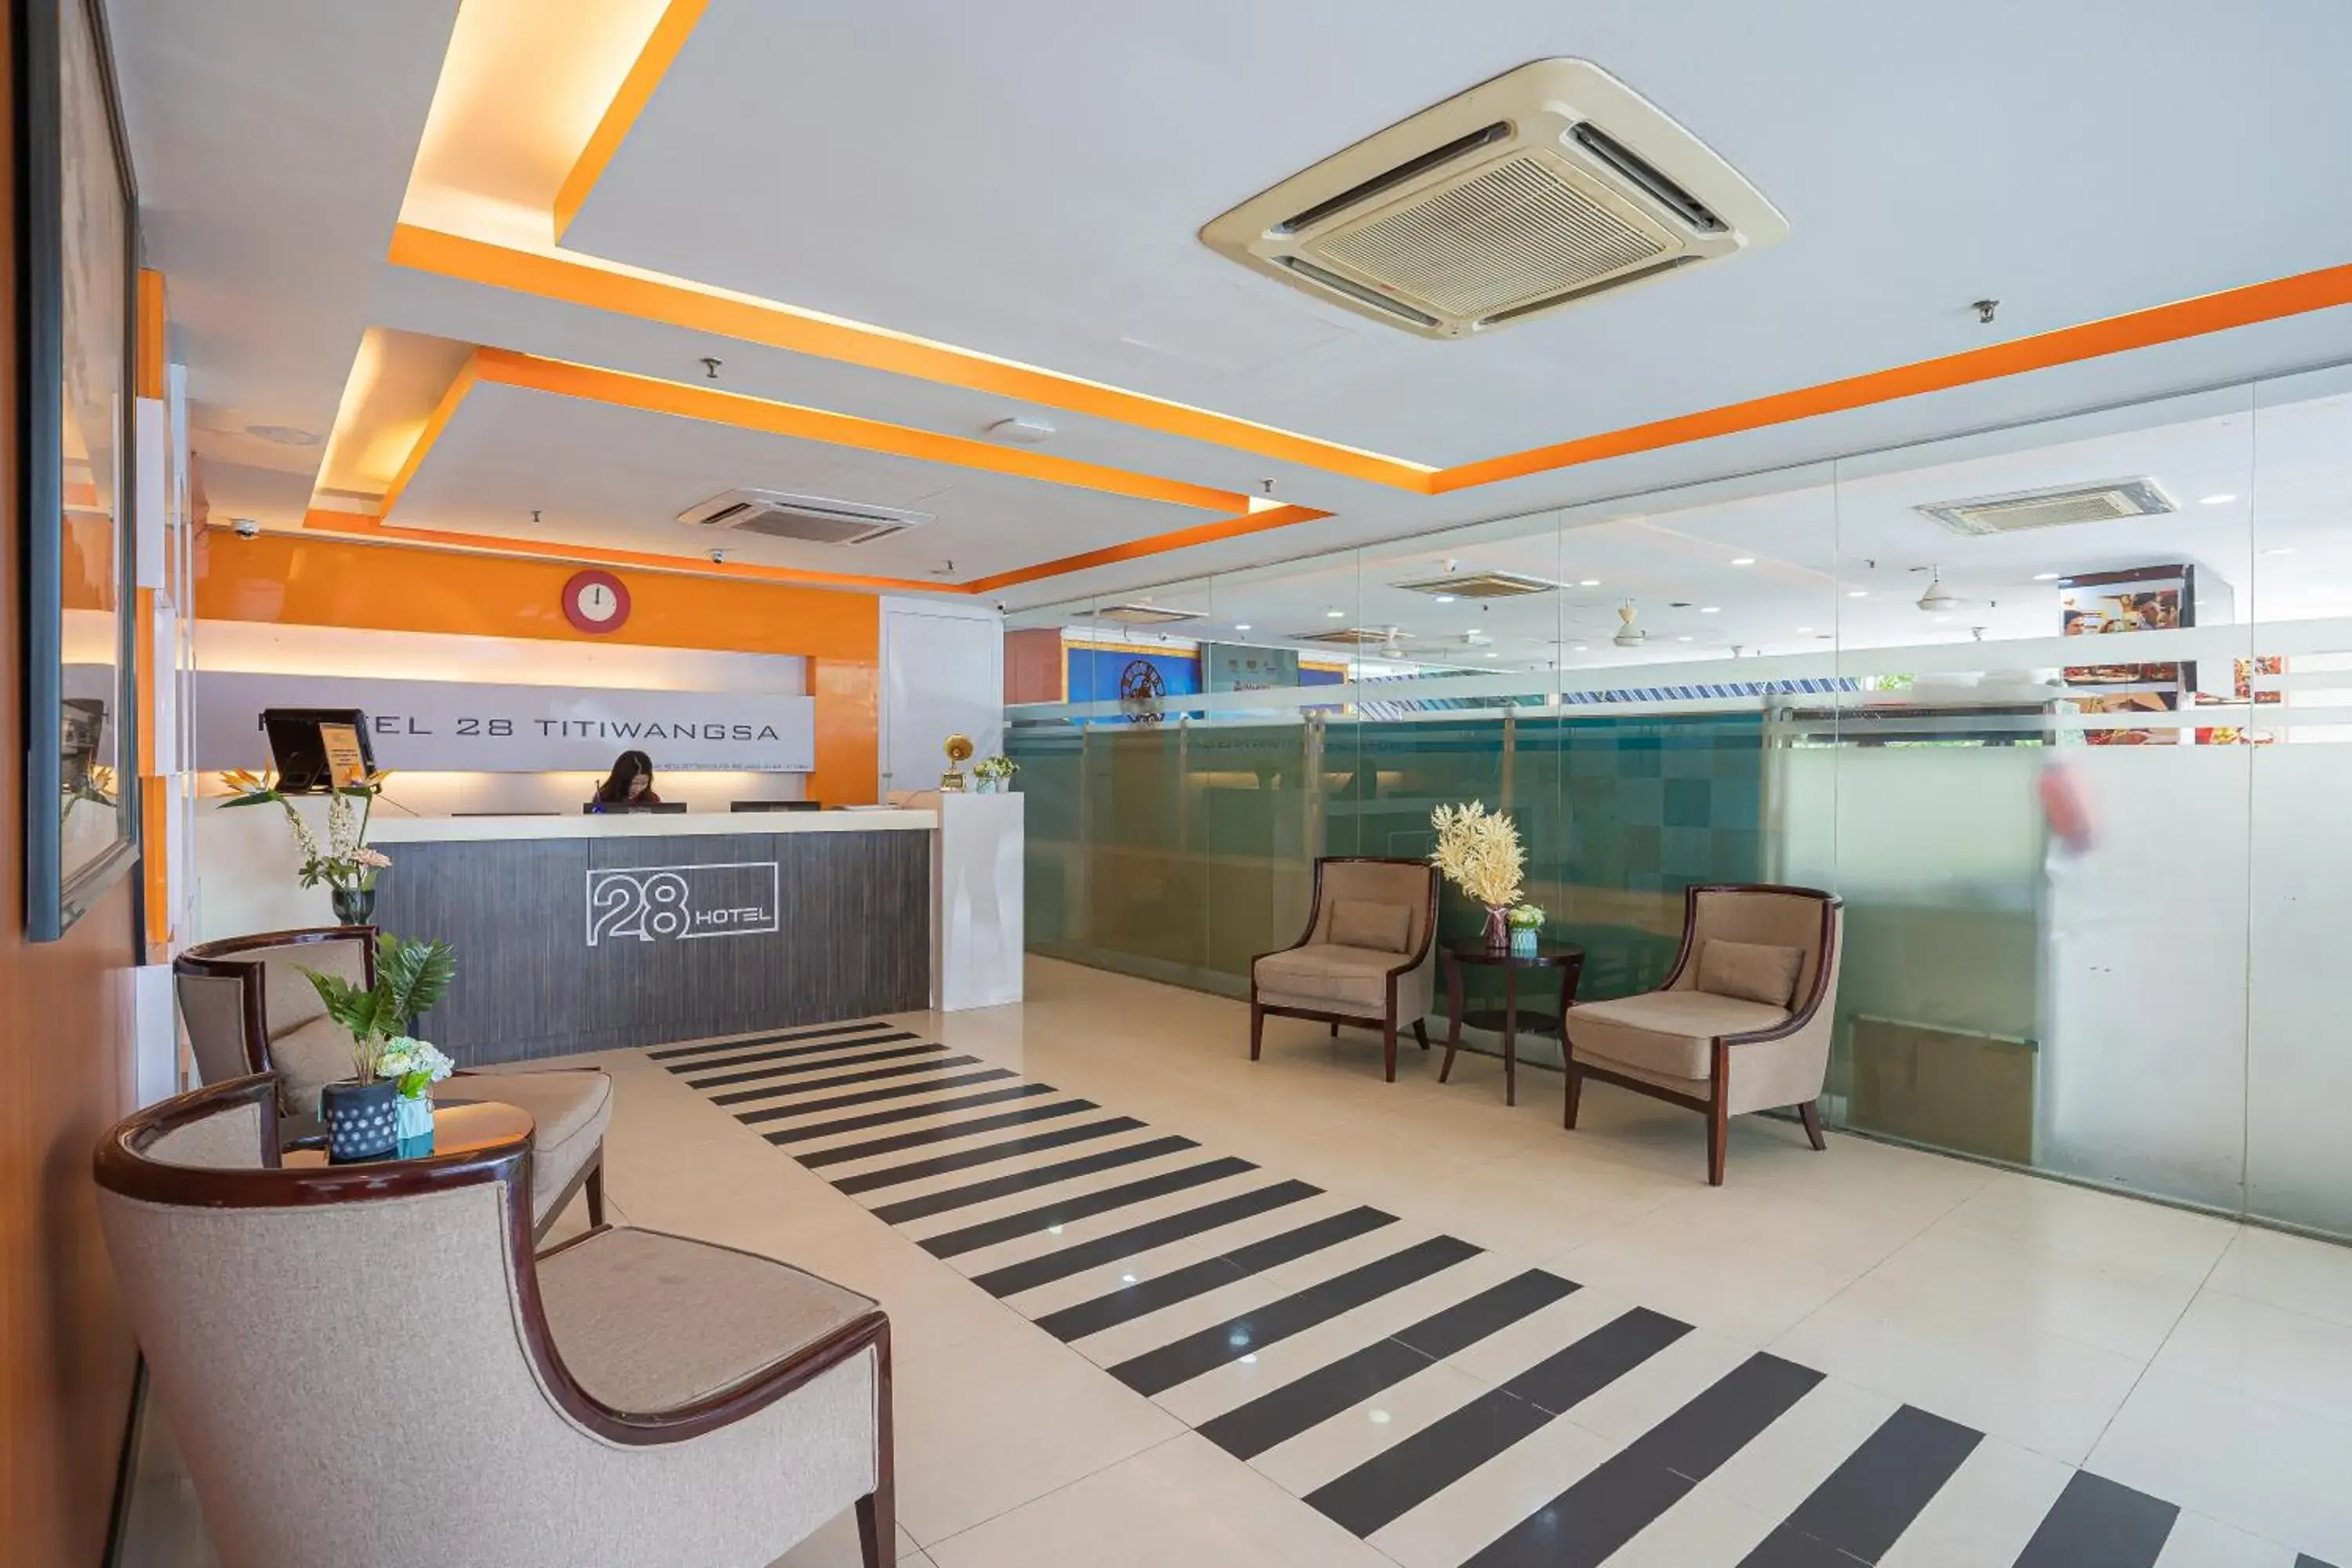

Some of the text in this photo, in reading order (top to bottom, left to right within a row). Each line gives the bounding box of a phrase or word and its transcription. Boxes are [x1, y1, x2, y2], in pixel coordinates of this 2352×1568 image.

[456, 718, 514, 736] 28
[534, 719, 779, 741] TITIWANGSA
[593, 873, 691, 942] 28
[695, 907, 771, 924] HOTEL
